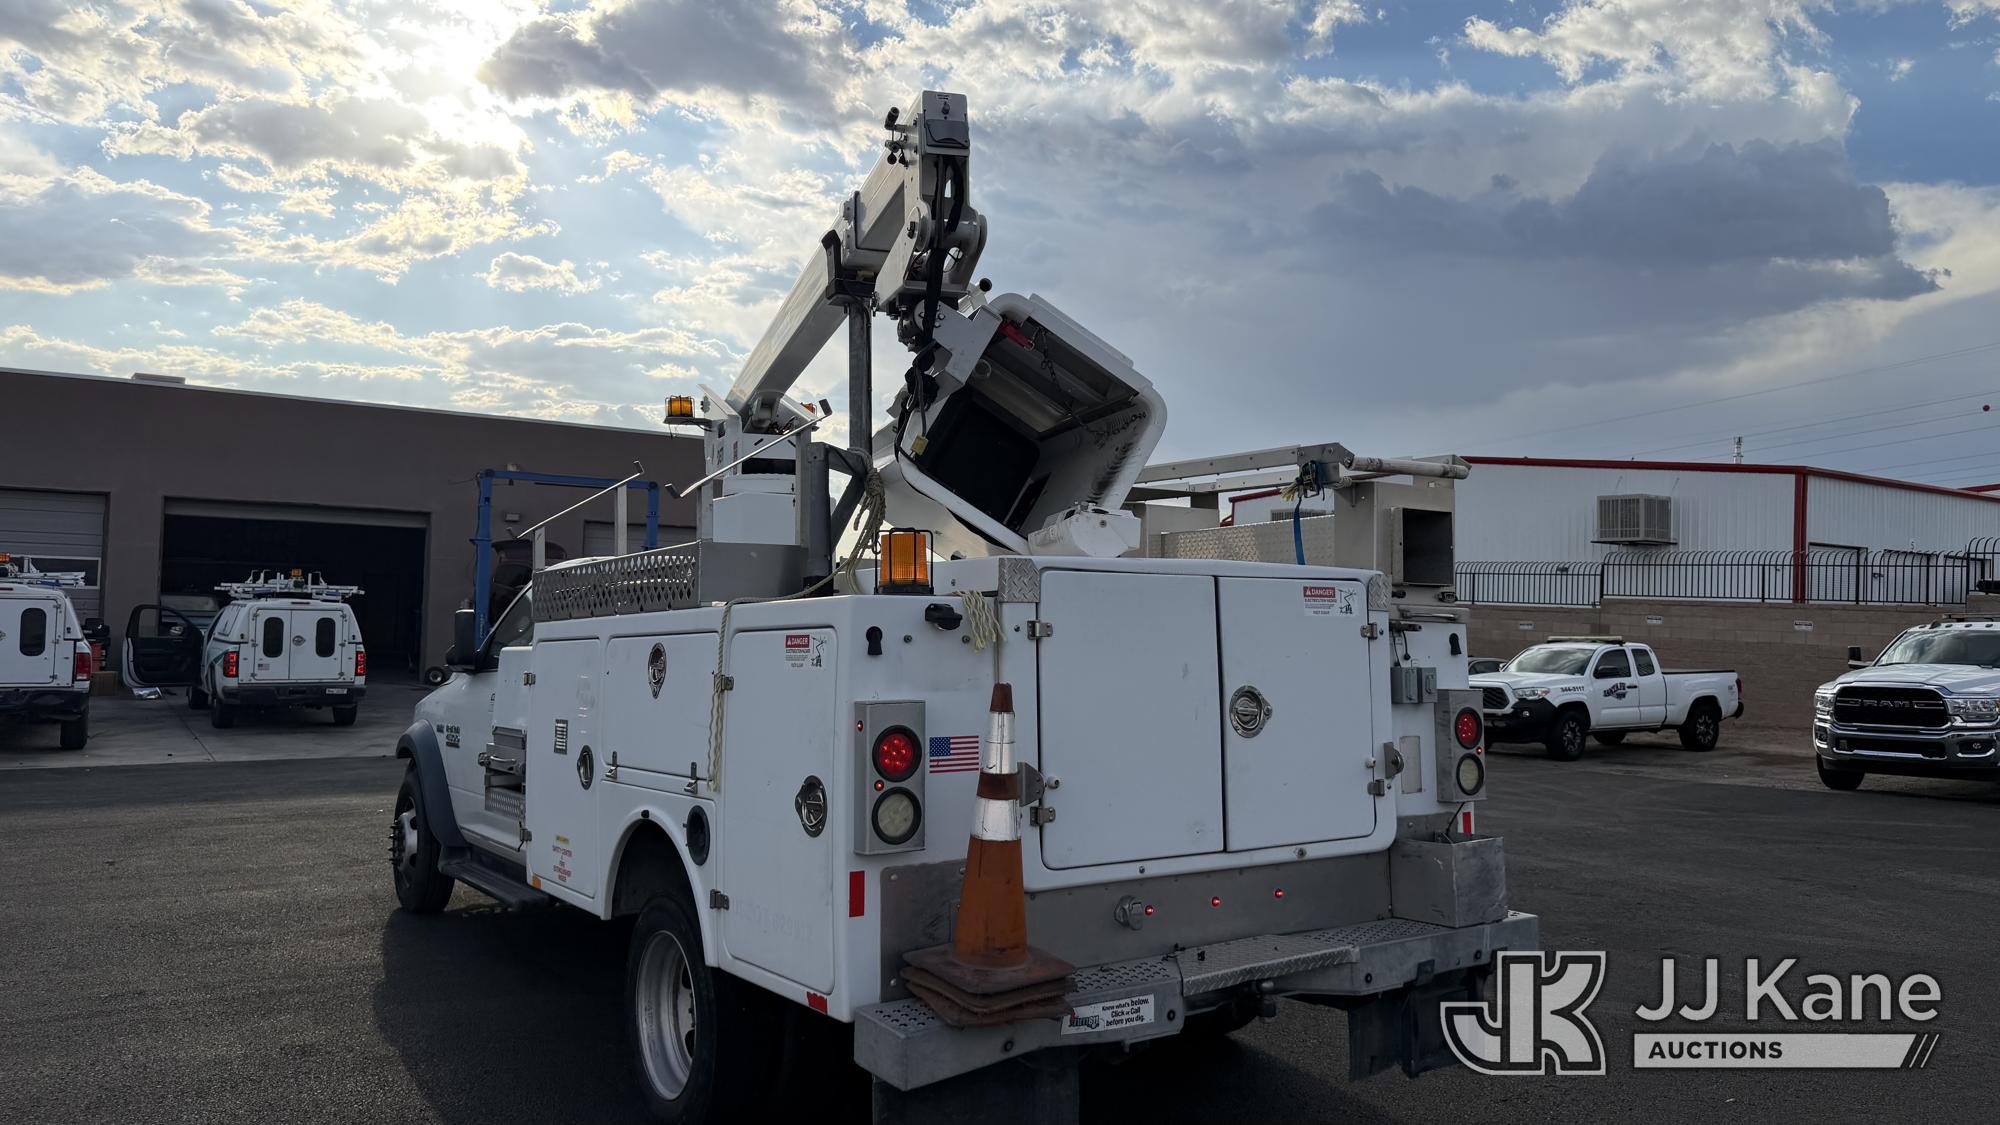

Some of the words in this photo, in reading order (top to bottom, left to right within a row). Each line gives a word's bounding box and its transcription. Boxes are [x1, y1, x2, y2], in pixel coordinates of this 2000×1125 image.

[1311, 588, 1334, 596] DANGER
[791, 637, 809, 645] DANGER
[1863, 699, 1910, 708] RAM
[1130, 998, 1150, 1006] below.
[1111, 1010, 1125, 1018] Click
[1130, 1007, 1141, 1015] Call
[1105, 1018, 1124, 1027] before
[1124, 1017, 1135, 1025] you
